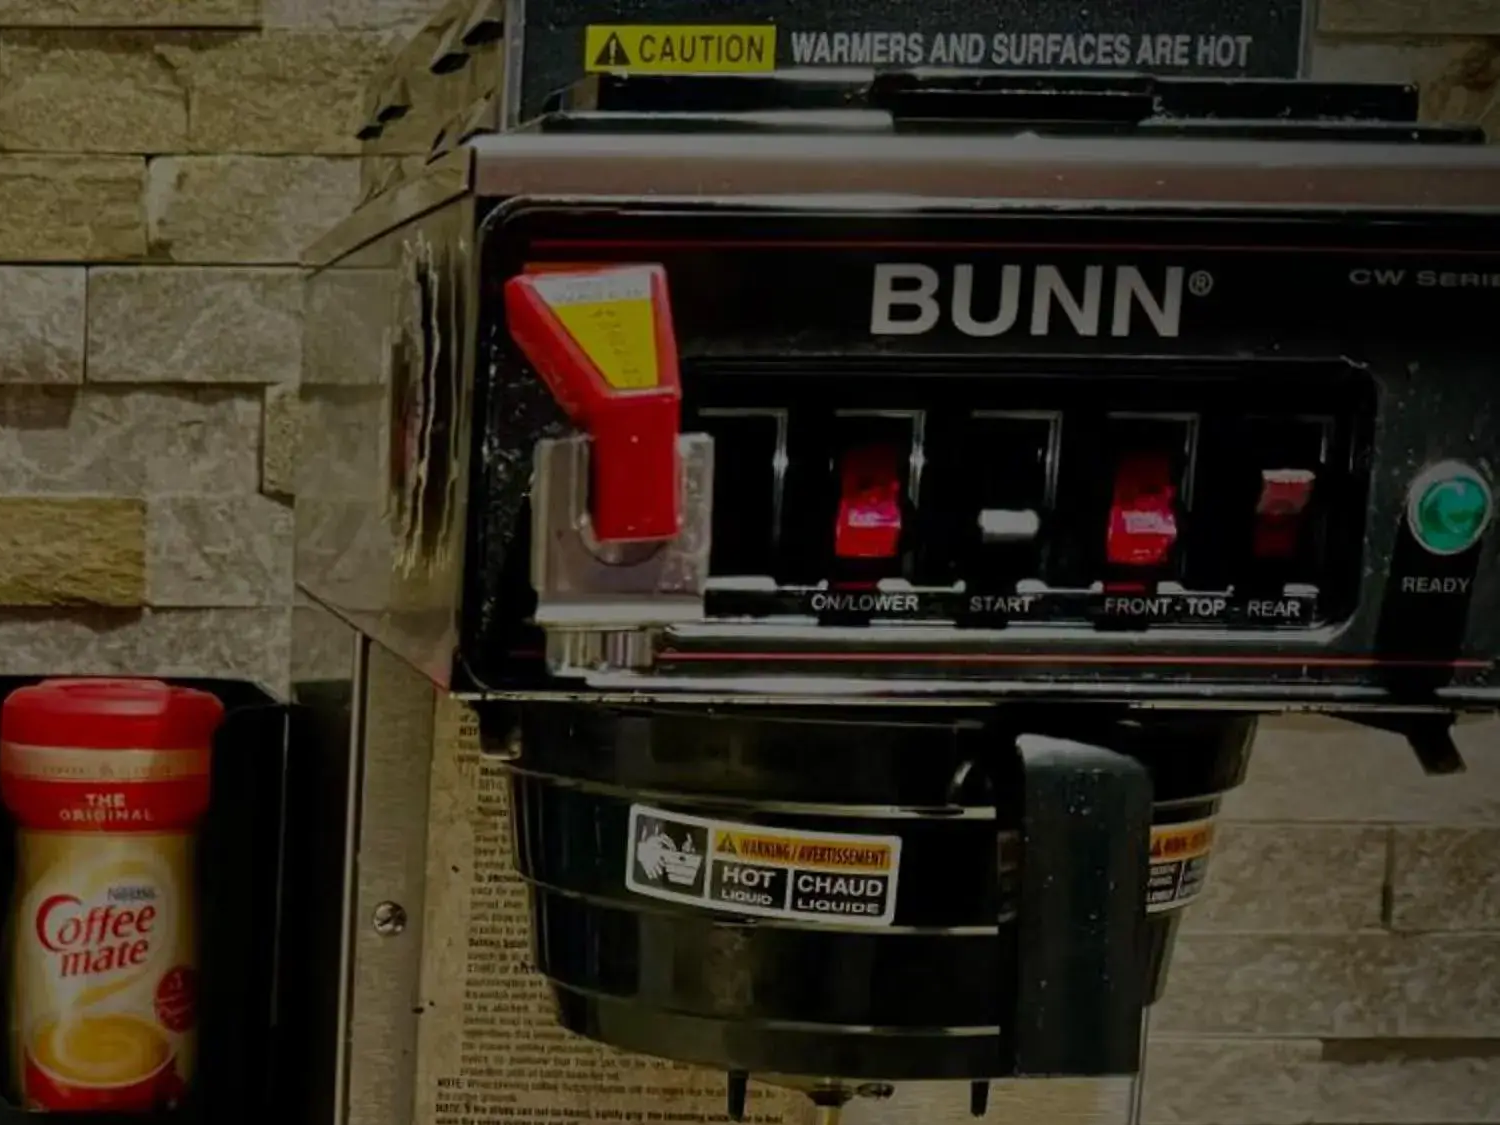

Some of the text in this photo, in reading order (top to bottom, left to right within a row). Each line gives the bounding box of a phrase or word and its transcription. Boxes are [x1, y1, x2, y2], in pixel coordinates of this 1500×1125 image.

[638, 31, 1253, 68] CAUTION WARMERS AND SURFACES ARE HOT
[1348, 267, 1407, 287] CW
[1400, 575, 1472, 594] READY
[810, 594, 920, 613] ON/LOWER
[968, 595, 1034, 613] START
[1103, 597, 1301, 618] FRONT TOP REAR
[84, 792, 126, 807] THE
[58, 808, 156, 823] ORIGINAL
[721, 865, 777, 889] HOT
[796, 873, 884, 898] CHAUD
[720, 889, 774, 906] LIQUID
[796, 897, 881, 915] LIQUIDE
[36, 894, 156, 952] Coffee
[59, 939, 150, 977] mate
